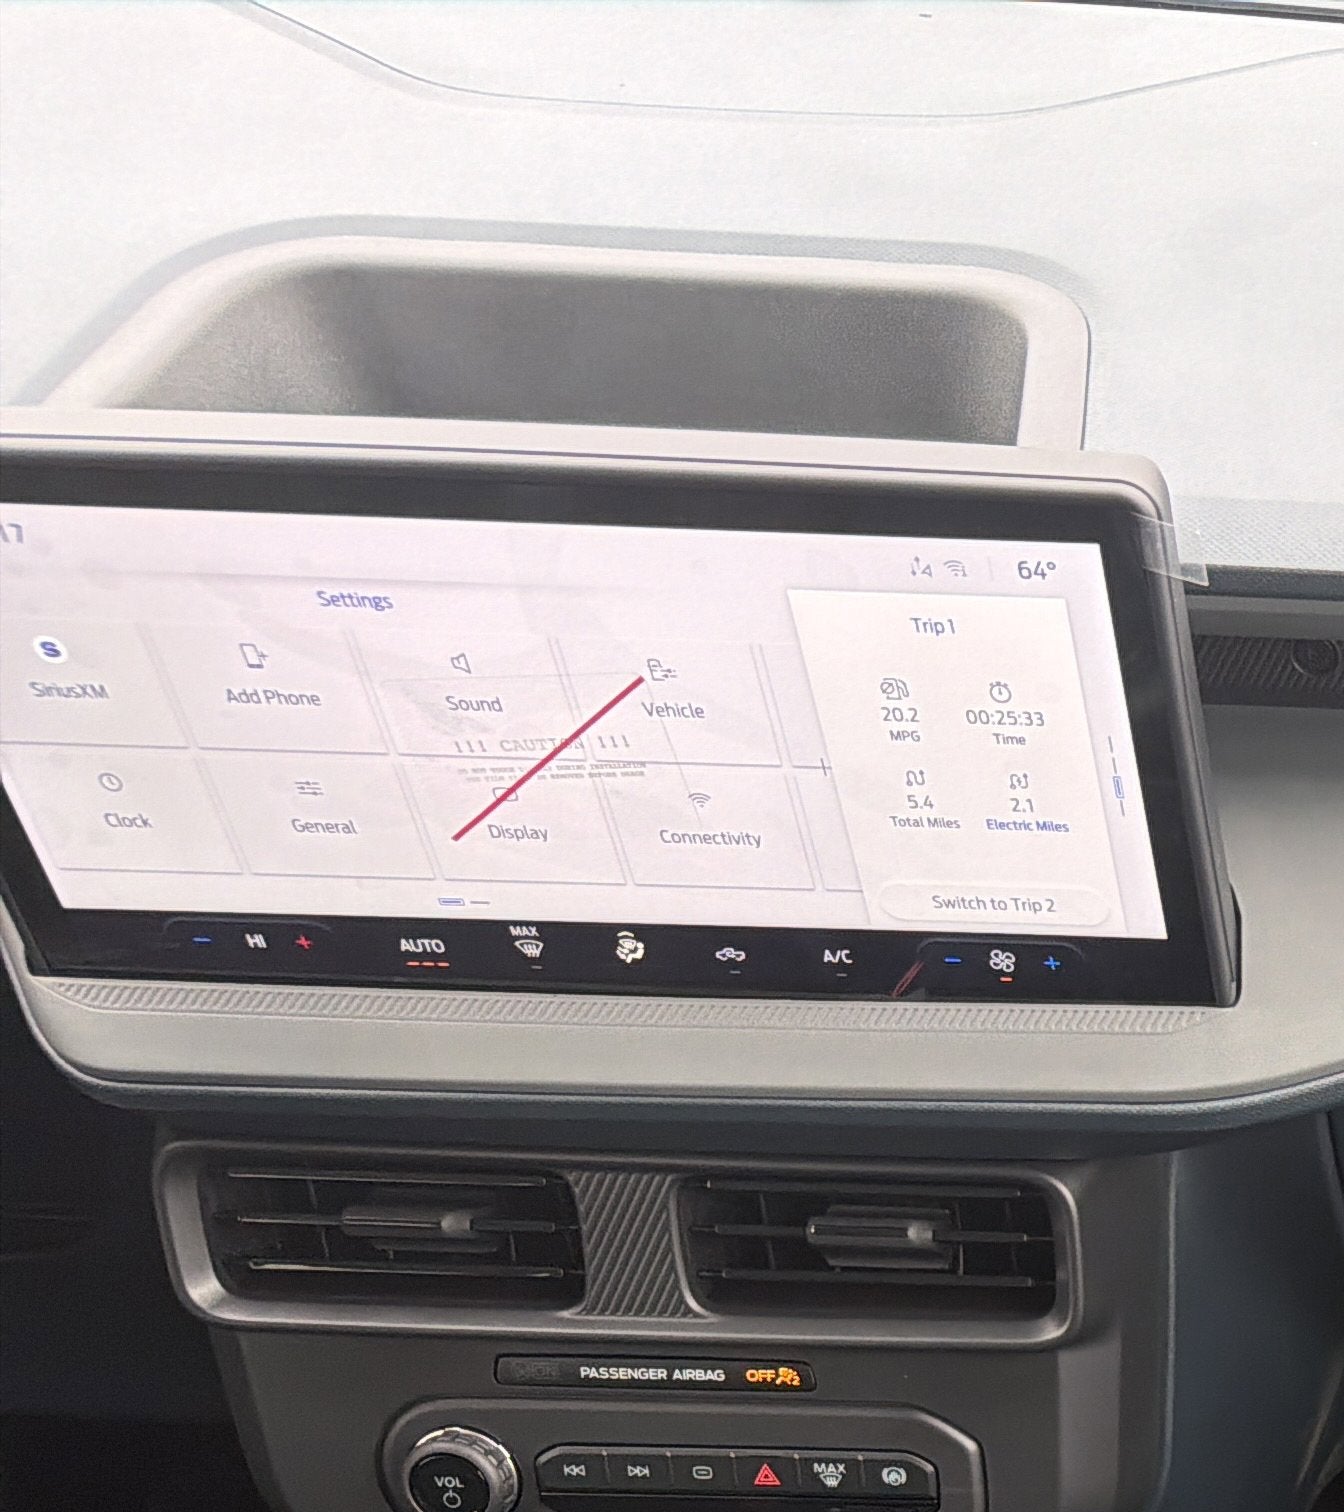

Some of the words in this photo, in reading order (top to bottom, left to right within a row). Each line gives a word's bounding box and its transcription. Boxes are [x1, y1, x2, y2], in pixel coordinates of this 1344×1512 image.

[316, 589, 394, 613] Settings
[910, 617, 945, 636] Trip
[28, 680, 109, 700] SiriusXM
[226, 688, 261, 706] Add
[263, 689, 321, 709] Phone
[445, 695, 503, 714] Sound
[641, 701, 705, 720] Vehicle
[881, 707, 920, 725] 20.2
[965, 709, 1045, 729] 00:25:33
[499, 736, 585, 753] CAUTIN
[890, 729, 921, 744] MPG
[992, 733, 1027, 747] Time
[907, 795, 934, 811] 5.4
[1011, 798, 1034, 813] 2.1
[104, 811, 153, 831] Clock
[291, 818, 358, 836] General
[890, 816, 923, 829] Total
[925, 816, 960, 830] Miles
[986, 818, 1034, 833] Electric
[1035, 820, 1070, 834] Miles
[487, 824, 549, 843] Display
[659, 828, 762, 850] Connectivity
[932, 895, 986, 911] Switch
[990, 897, 1008, 912] to
[1011, 897, 1042, 916] Trip
[1045, 898, 1057, 914] 2
[509, 925, 540, 938] MAX
[245, 933, 267, 949] HI
[400, 938, 446, 955] AUTO
[823, 948, 853, 965] A/C
[580, 1366, 667, 1380] PASSENGER
[672, 1369, 726, 1382] AIRBAG
[745, 1369, 776, 1383] OFF
[813, 1462, 846, 1475] MAX
[434, 1475, 465, 1490] VOL
